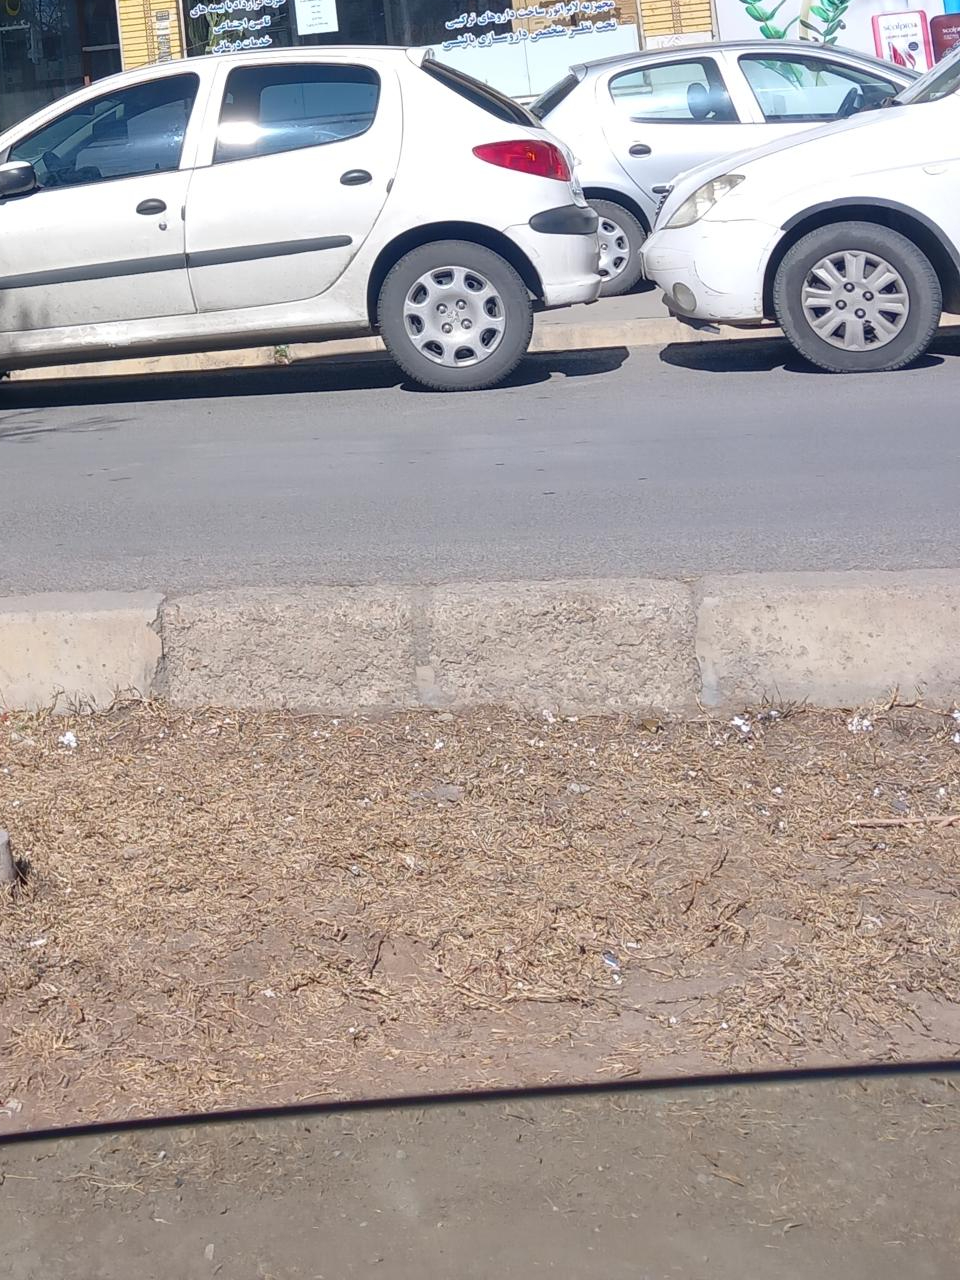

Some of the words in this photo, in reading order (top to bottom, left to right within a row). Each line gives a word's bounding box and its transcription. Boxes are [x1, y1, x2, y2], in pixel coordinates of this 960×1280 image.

[517, 6, 546, 19] ساخت
[546, 0, 580, 18] لابراتور
[581, 2, 592, 12] به
[592, 0, 615, 13] مجهز
[213, 17, 248, 34] اجتماعی
[445, 12, 476, 30] ترکیبی
[478, 8, 516, 27] داروهای
[595, 18, 618, 31] تحت
[530, 23, 567, 41] متخصص
[569, 20, 594, 37] نظر
[212, 39, 242, 54] درمانی
[242, 34, 273, 49] خدمات
[477, 29, 528, 47] داروسازی
